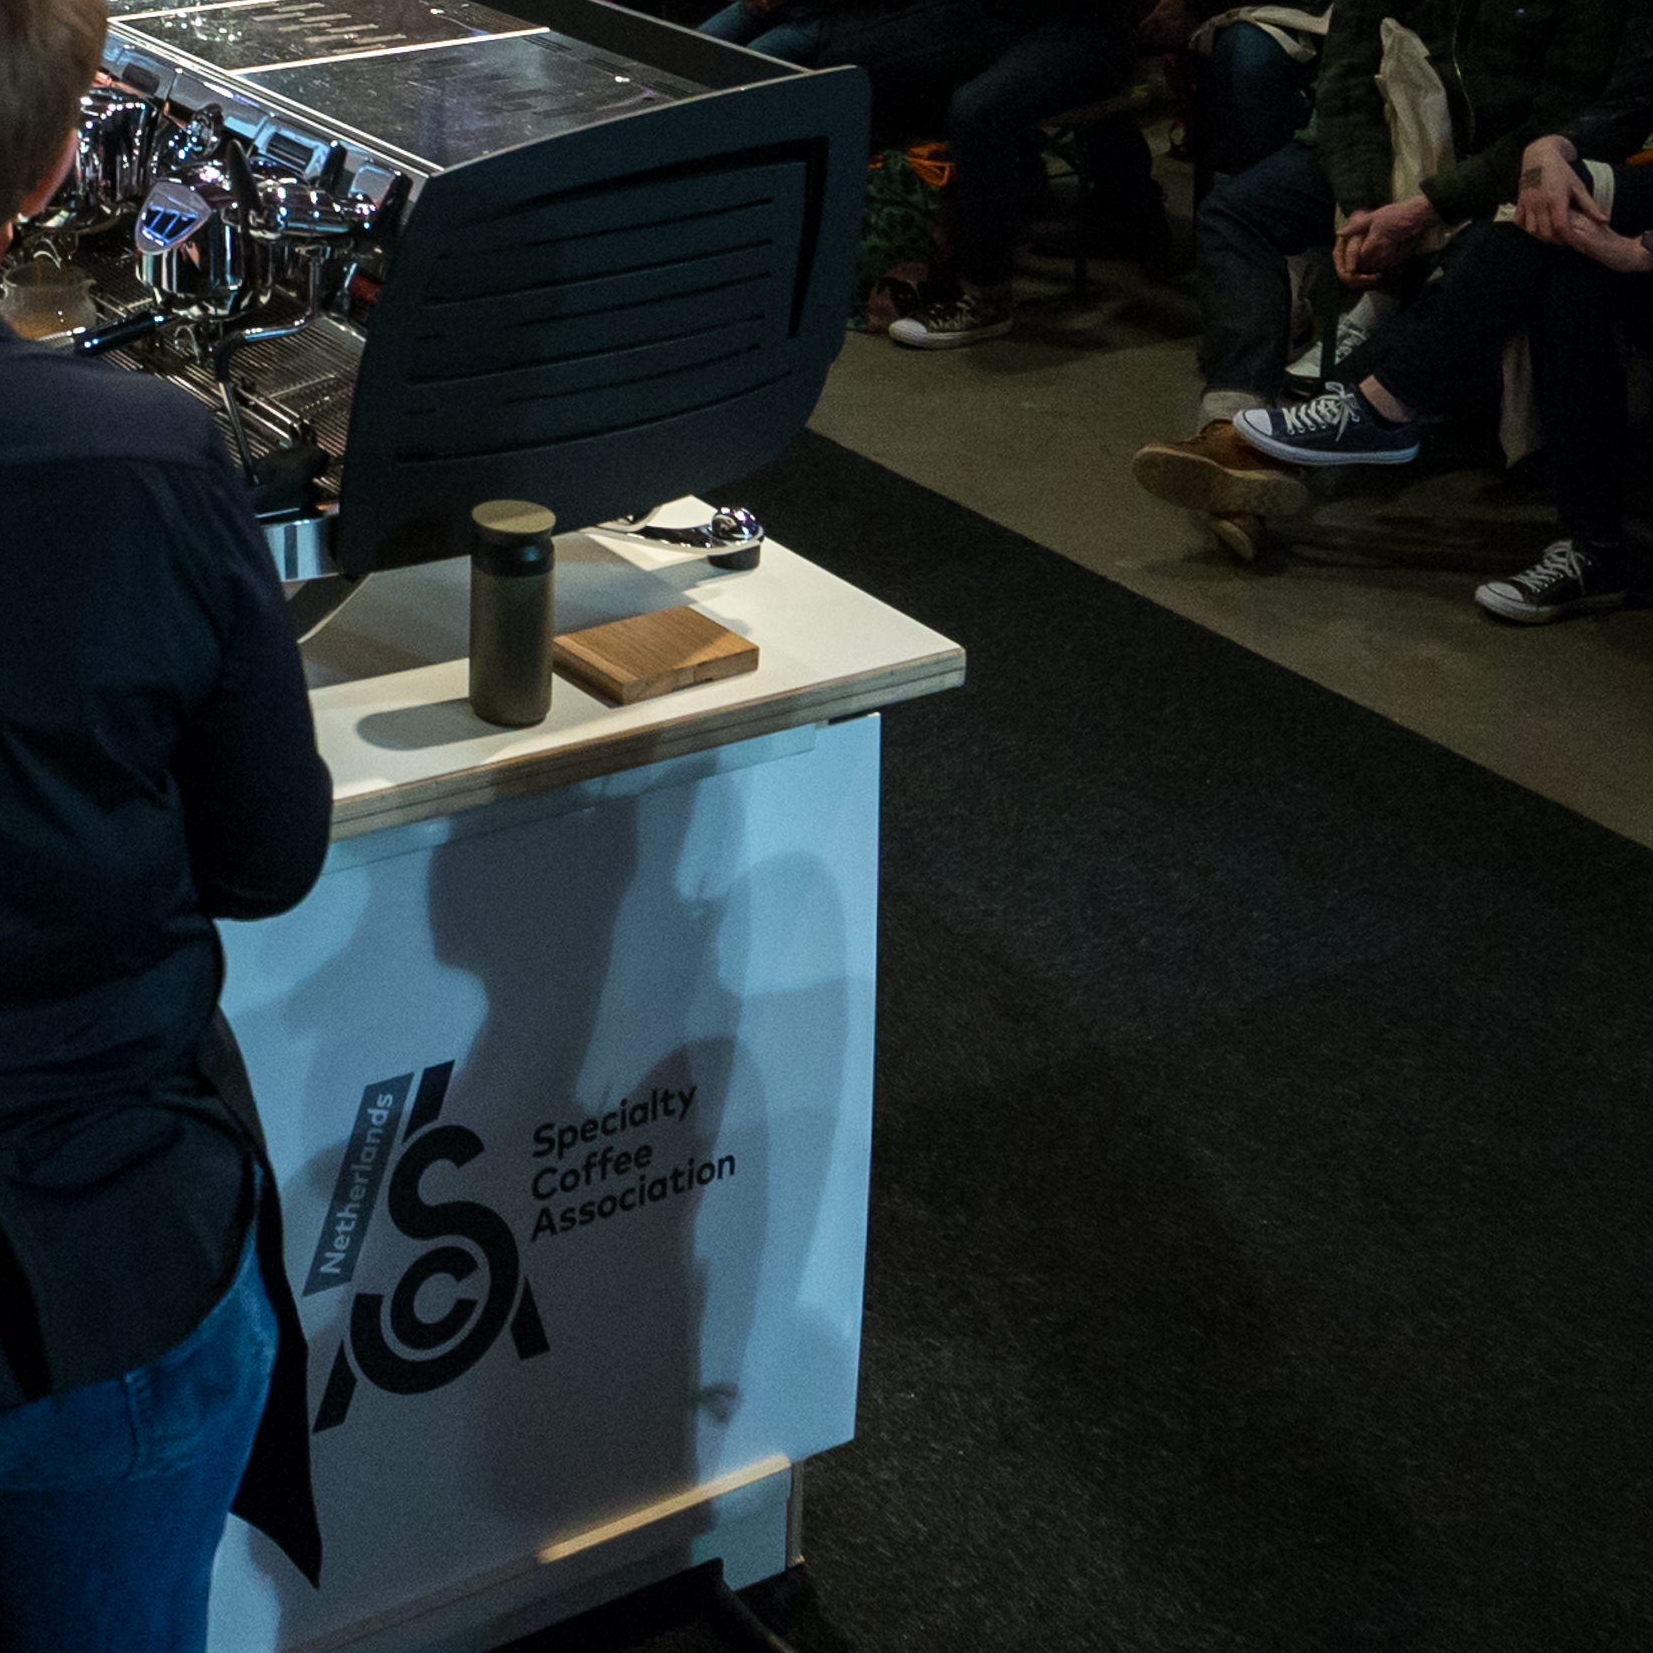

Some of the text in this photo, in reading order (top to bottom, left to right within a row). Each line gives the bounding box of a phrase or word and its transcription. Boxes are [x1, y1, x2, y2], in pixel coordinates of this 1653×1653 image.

[531, 1084, 697, 1159] Specialty
[319, 1092, 394, 1276] Netherlands
[530, 1145, 654, 1201] Coffee
[530, 1153, 736, 1243] Association
